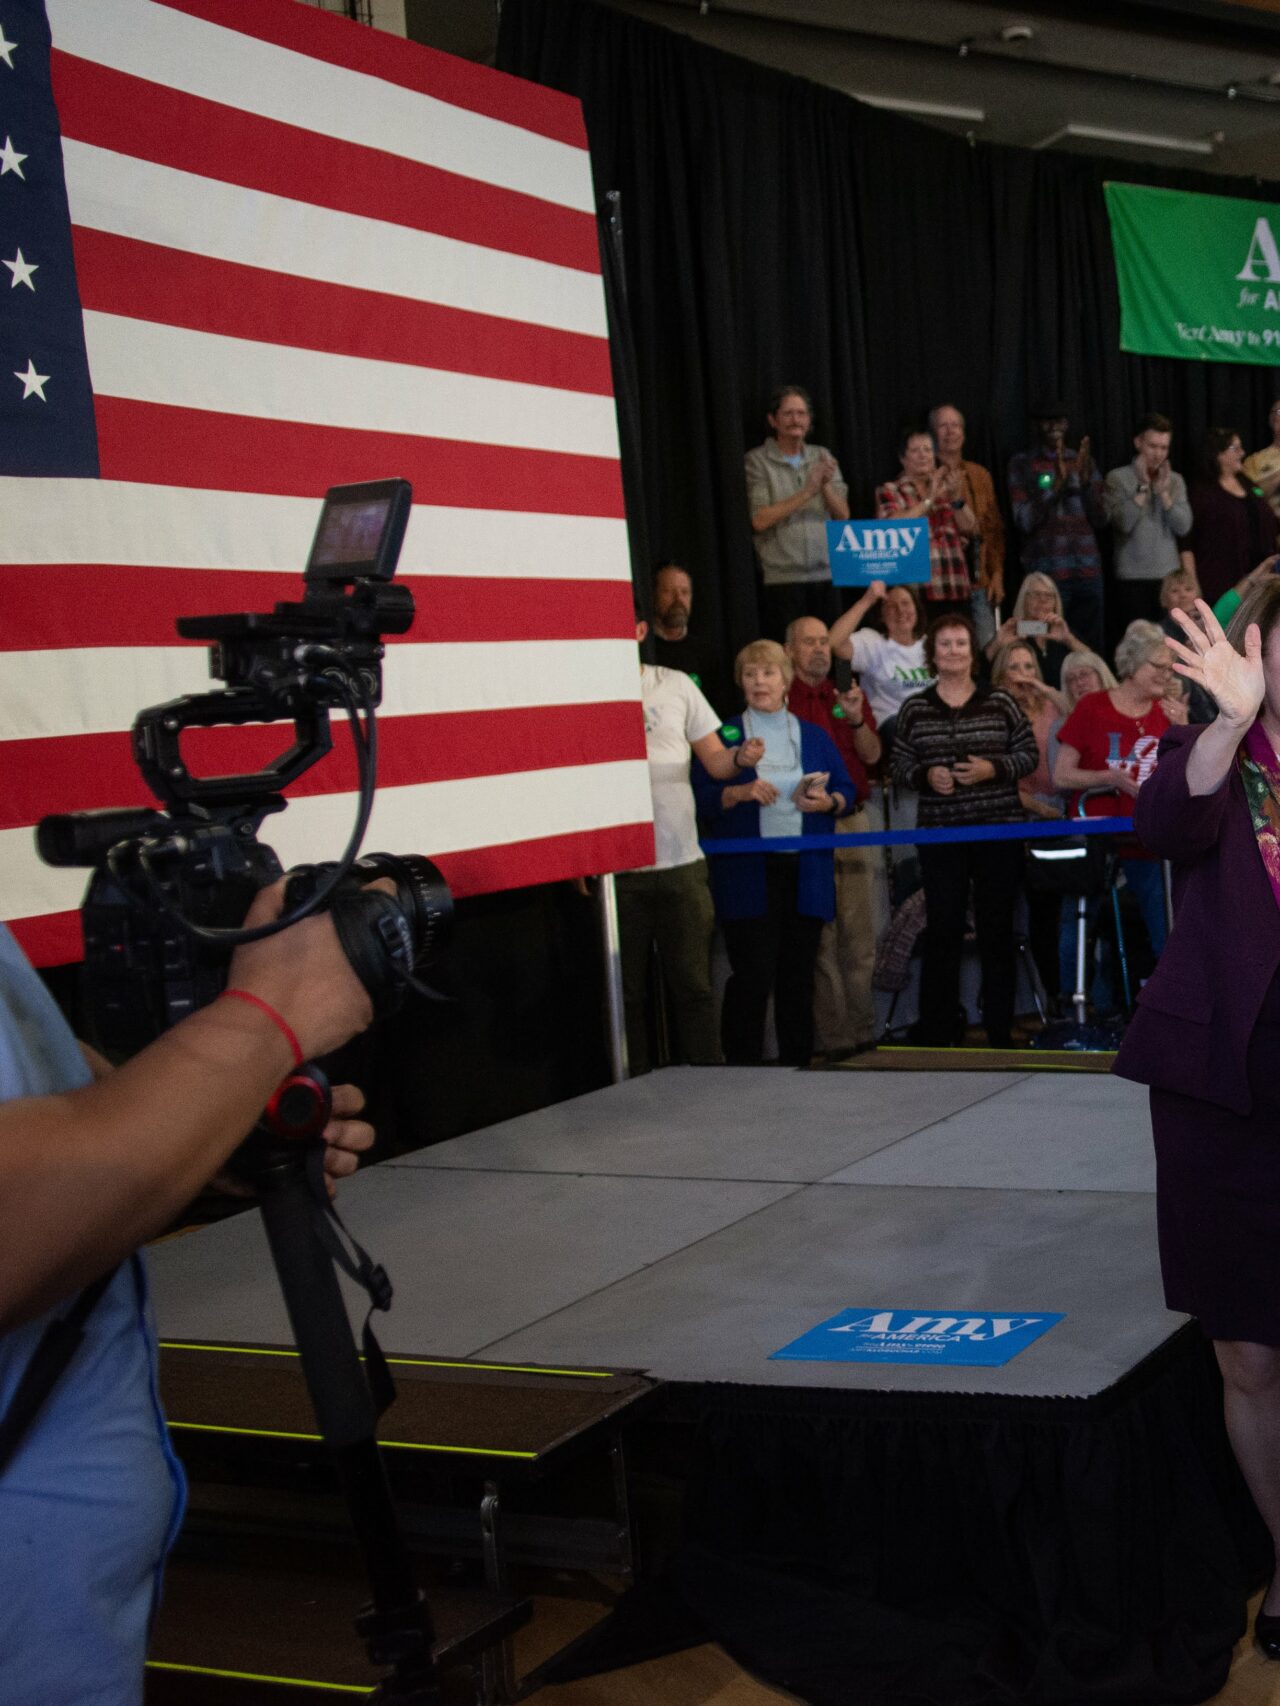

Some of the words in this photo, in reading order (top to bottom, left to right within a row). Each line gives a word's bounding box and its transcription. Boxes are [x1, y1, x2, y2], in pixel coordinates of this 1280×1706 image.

[1237, 287, 1259, 309] for
[835, 524, 922, 556] Amy
[891, 665, 929, 681] Am
[827, 1312, 1043, 1341] Amy
[870, 1333, 960, 1342] AMERICA
